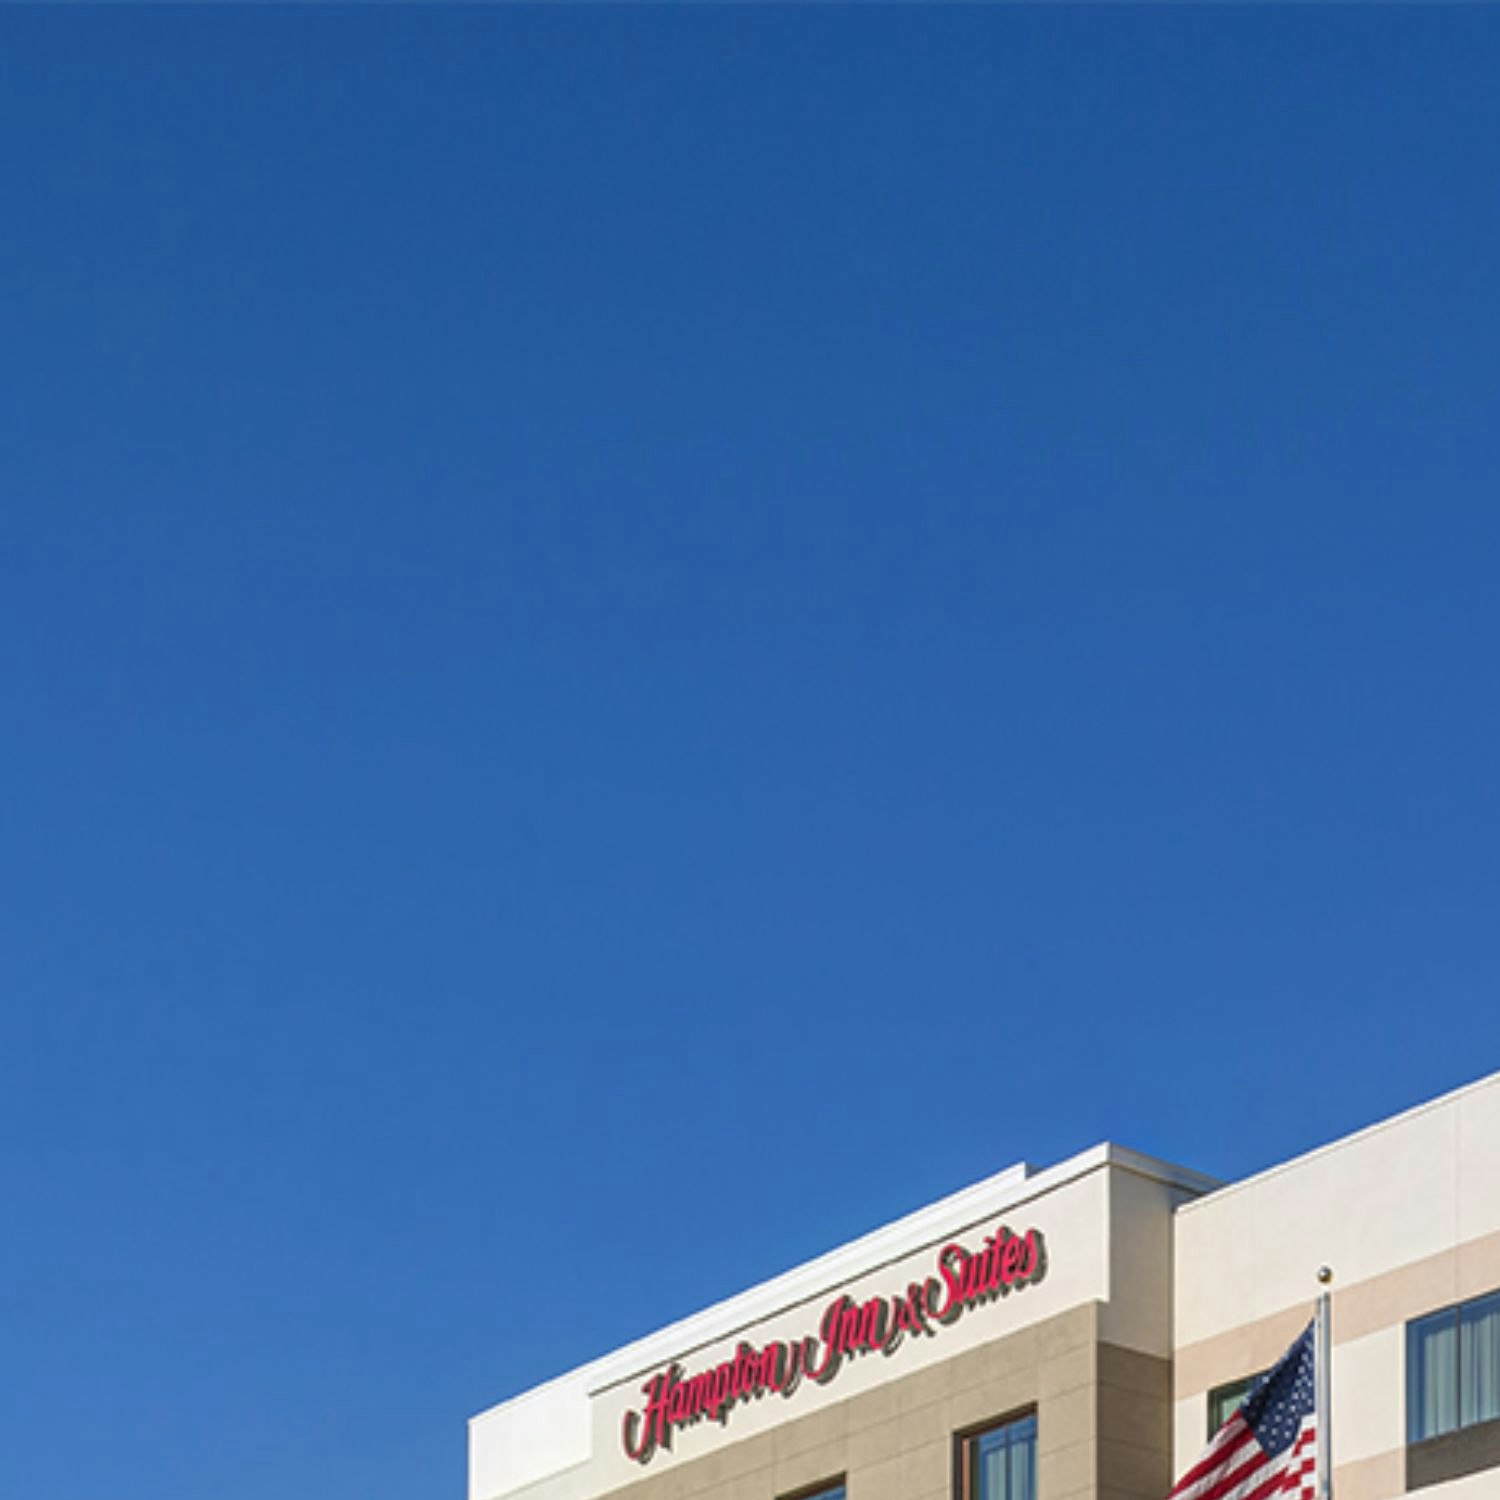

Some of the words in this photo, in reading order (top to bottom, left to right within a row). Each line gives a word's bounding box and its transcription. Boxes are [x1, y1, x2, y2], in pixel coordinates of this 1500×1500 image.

[623, 1340, 798, 1462] Hampton
[800, 1294, 900, 1383] Inn
[923, 1225, 1046, 1322] Suites
